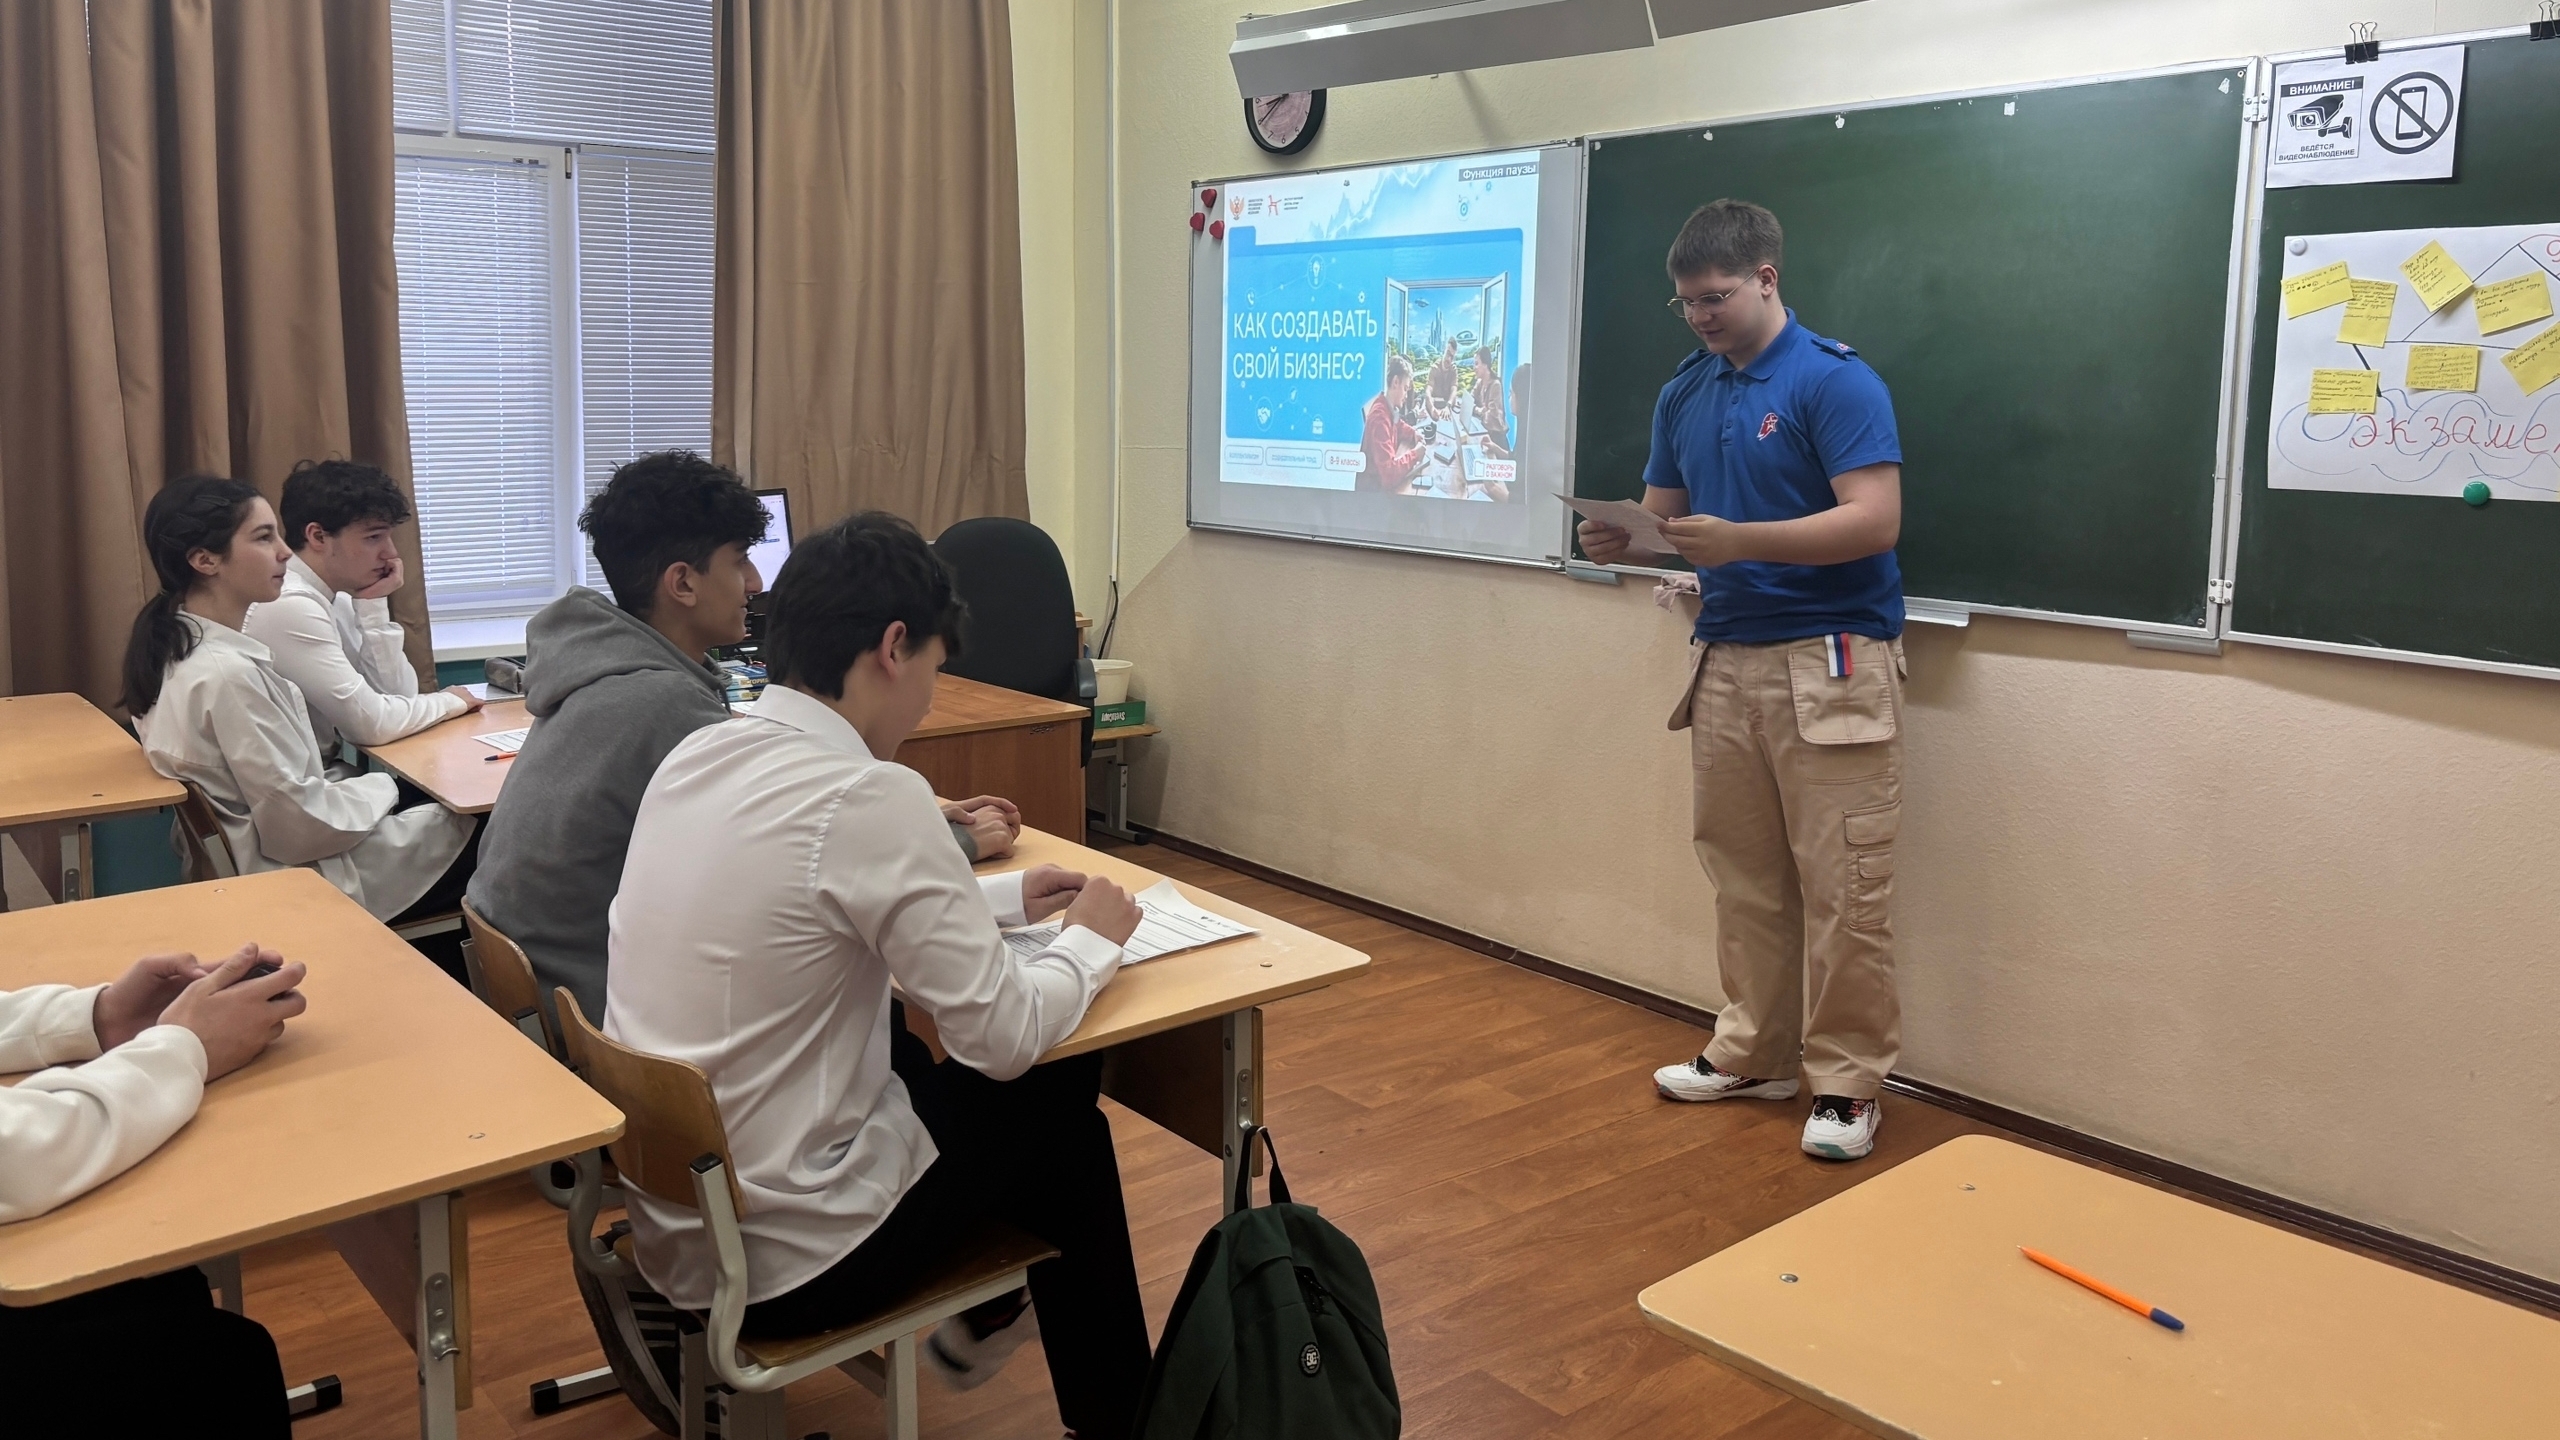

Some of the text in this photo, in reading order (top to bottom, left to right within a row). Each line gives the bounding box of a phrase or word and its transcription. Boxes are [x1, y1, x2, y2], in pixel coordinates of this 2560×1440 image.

[2290, 80, 2355, 95] ВНИМАНИЕ!
[1281, 135, 1286, 144] 6
[2278, 149, 2355, 161] ВИДЕОНАБЛЮДЕНИЕ
[2300, 143, 2334, 152] ВЕДЁТСЯ
[1463, 165, 1536, 180] Функция паузы
[1233, 309, 1378, 343] КАК СОЗДАВАТЬ
[1232, 346, 1365, 380] СВОЙ БИЗНЕС?
